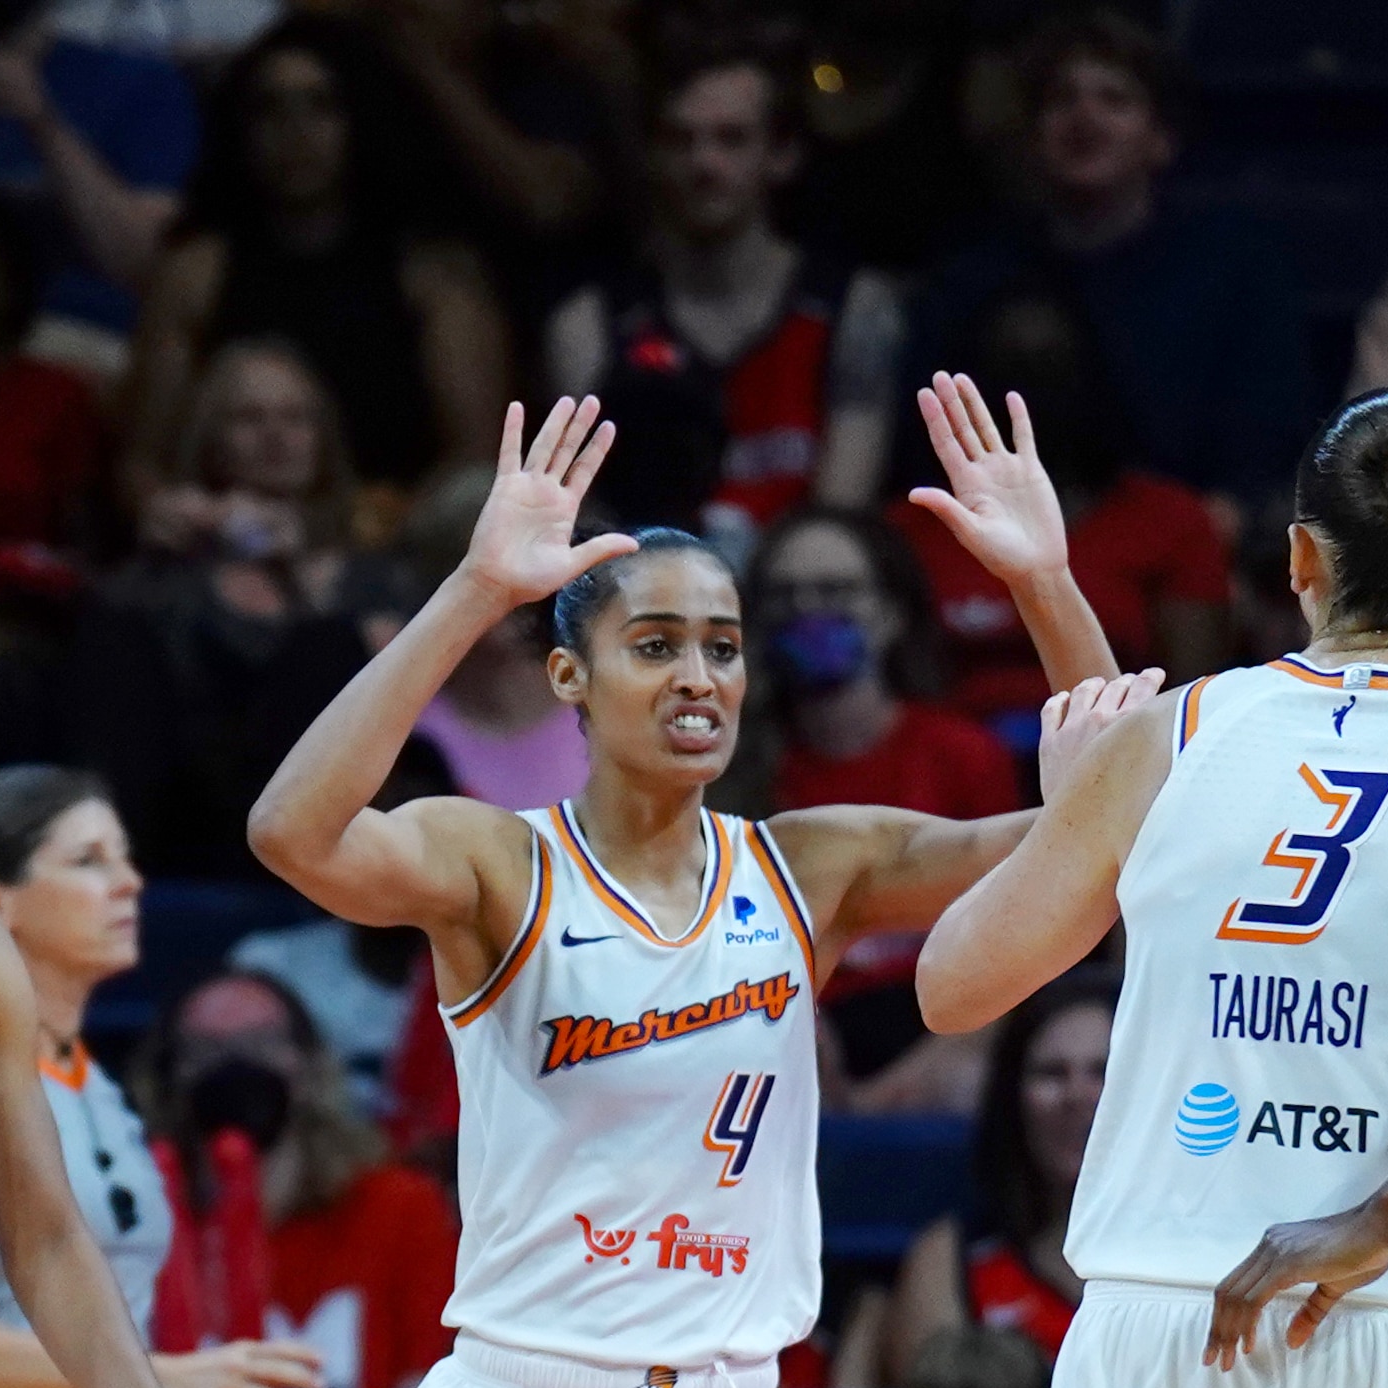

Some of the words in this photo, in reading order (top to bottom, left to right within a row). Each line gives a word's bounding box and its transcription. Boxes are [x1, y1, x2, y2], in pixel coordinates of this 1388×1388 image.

[725, 928, 780, 946] PayPal
[538, 971, 799, 1079] Mercury
[1209, 973, 1368, 1048] TAURASI
[702, 1069, 776, 1188] 4
[1246, 1101, 1379, 1153] AT&T
[646, 1213, 750, 1277] fry's
[677, 1233, 706, 1244] FOOD
